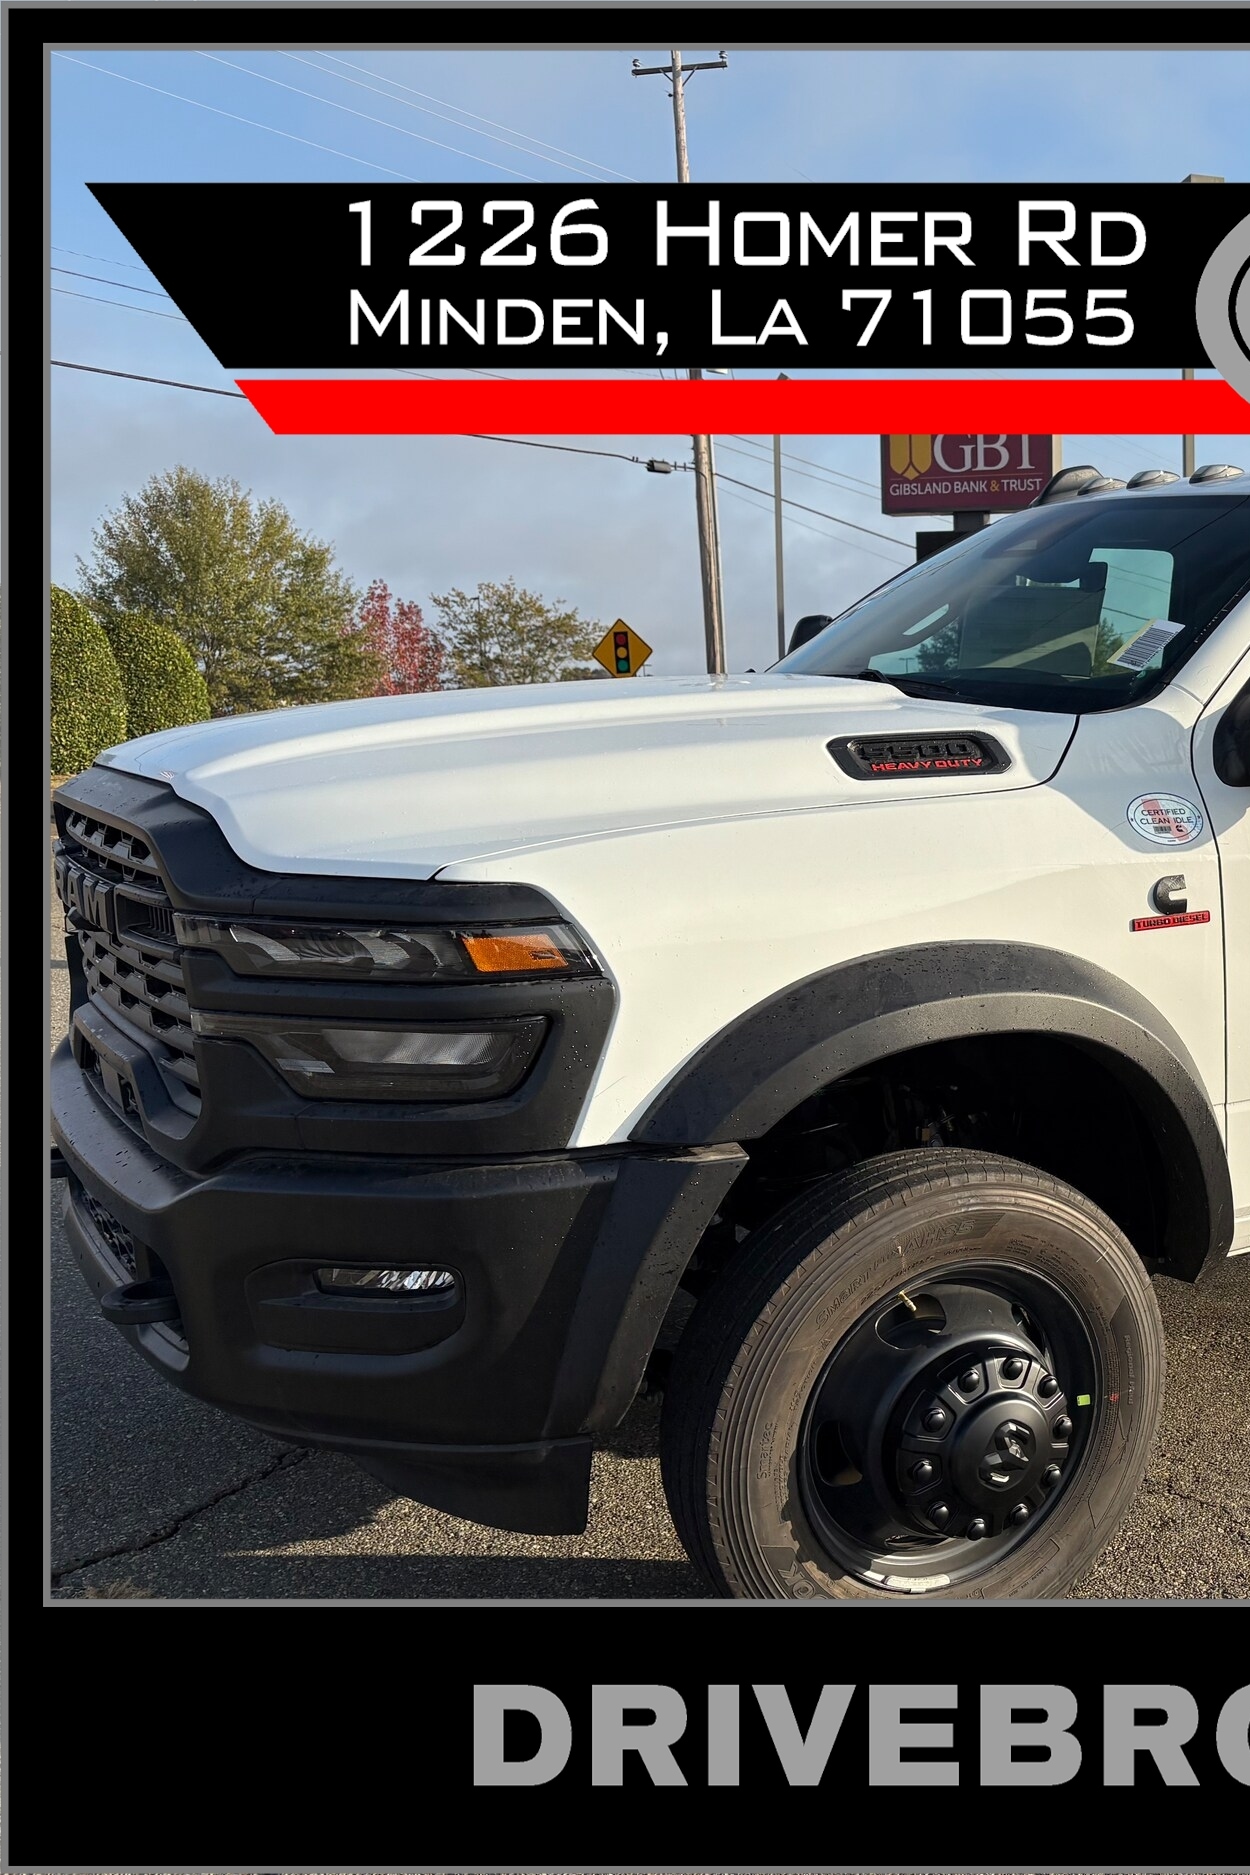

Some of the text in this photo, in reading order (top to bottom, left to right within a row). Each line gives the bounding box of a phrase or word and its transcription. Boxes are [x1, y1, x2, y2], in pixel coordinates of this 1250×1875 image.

[889, 478, 1043, 496] GIBSLAND BANK & TRUST
[859, 740, 975, 762] 5500
[871, 758, 983, 772] HEAVY DUTY
[1140, 808, 1187, 817] CERTIFIED
[1139, 816, 1195, 826] CLEAN IDLE
[54, 856, 113, 935] RAM
[1135, 913, 1209, 929] TURBO DIESEL
